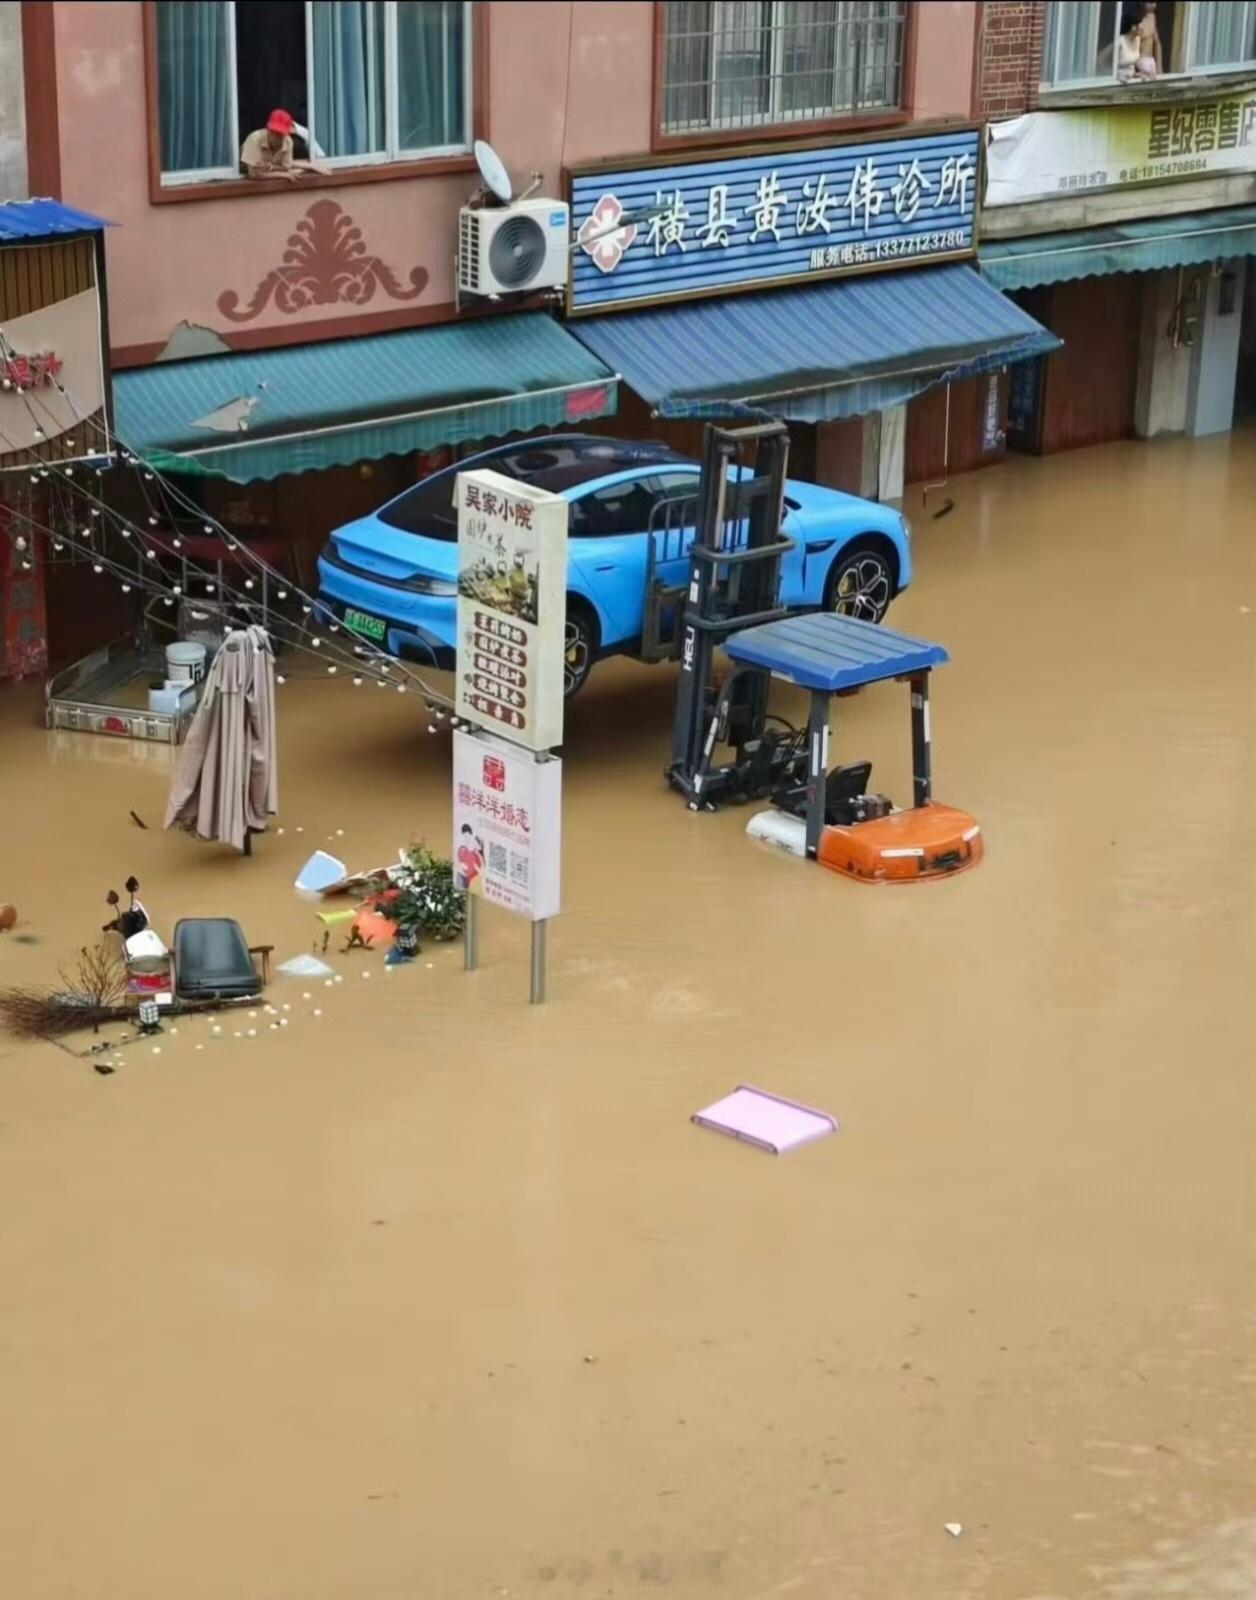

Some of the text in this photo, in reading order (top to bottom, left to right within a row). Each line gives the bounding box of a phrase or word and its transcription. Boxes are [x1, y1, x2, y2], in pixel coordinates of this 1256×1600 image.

[645, 153, 973, 257] 横县黄汝伟诊所
[465, 484, 534, 531] 吴家小院
